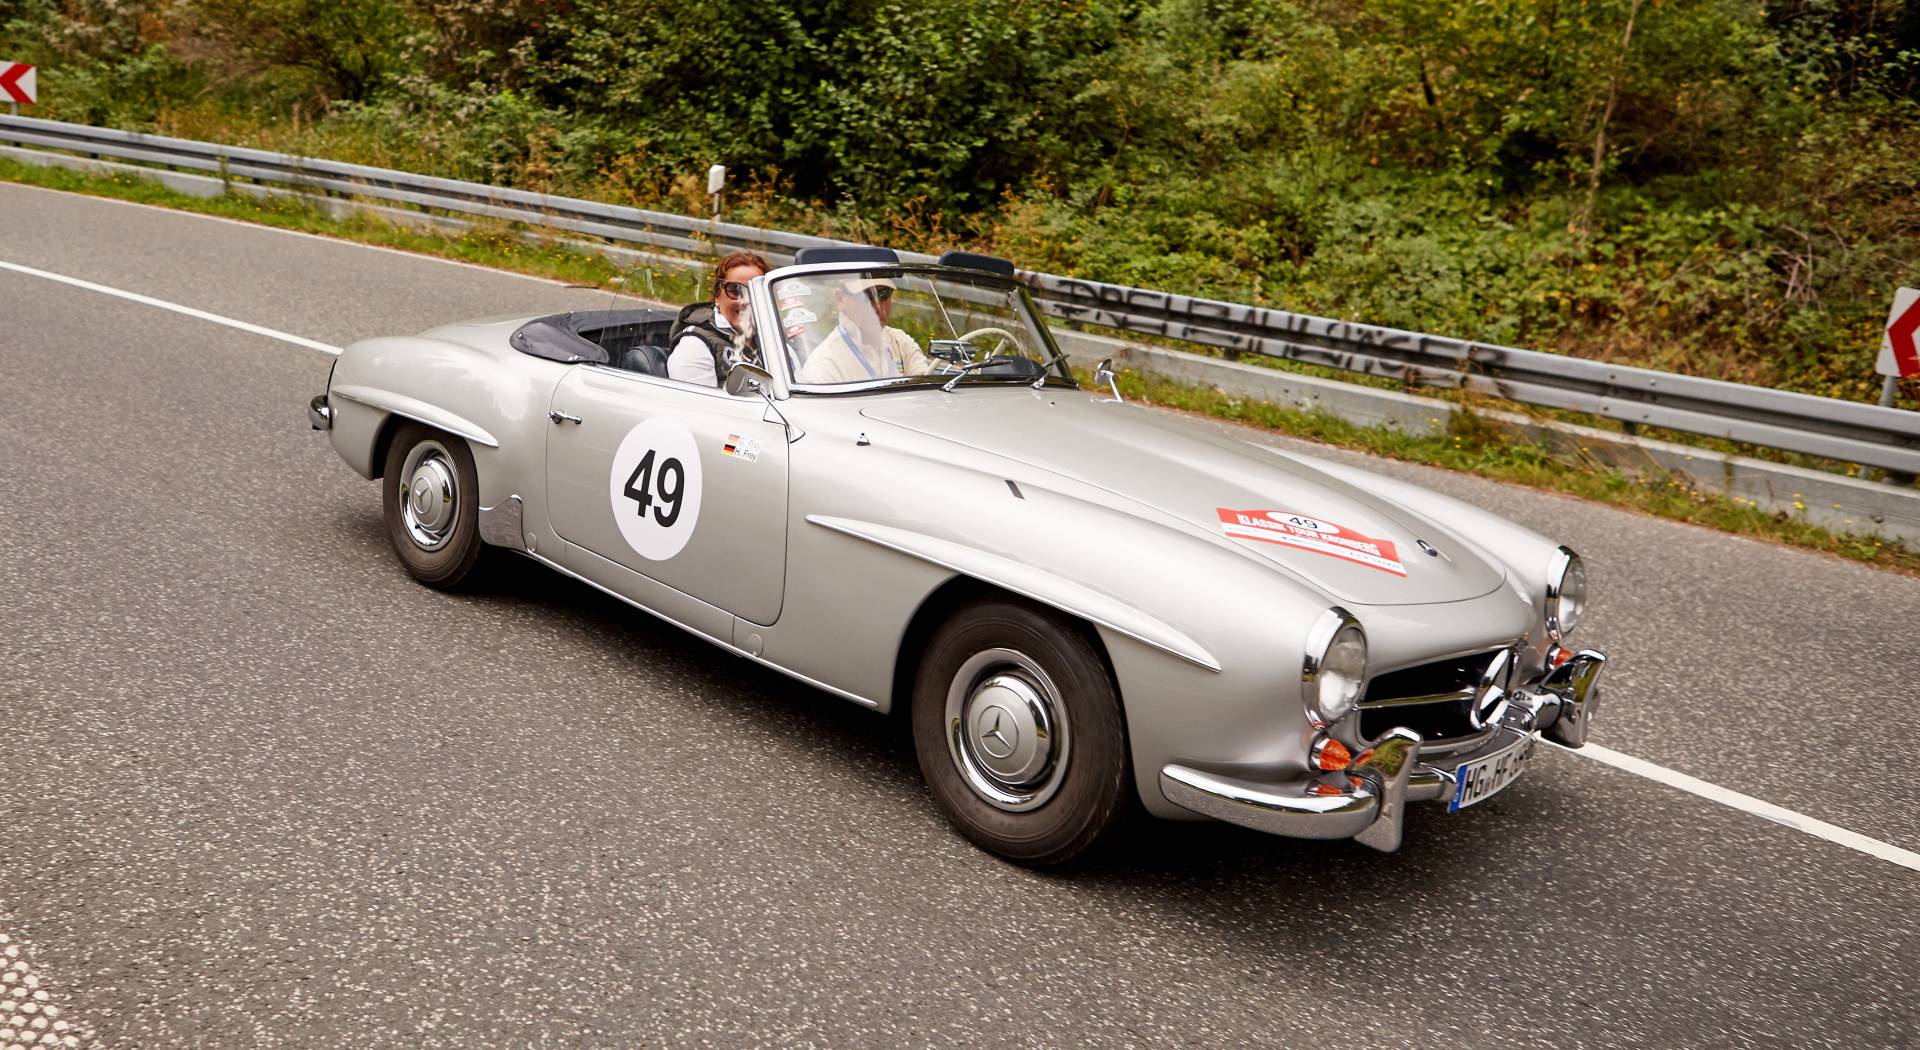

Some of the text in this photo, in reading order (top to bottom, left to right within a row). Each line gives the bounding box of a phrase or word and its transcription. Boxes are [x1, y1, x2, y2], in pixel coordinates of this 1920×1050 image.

[624, 449, 685, 527] 49
[1289, 517, 1318, 529] 49
[1463, 764, 1488, 802] HG
